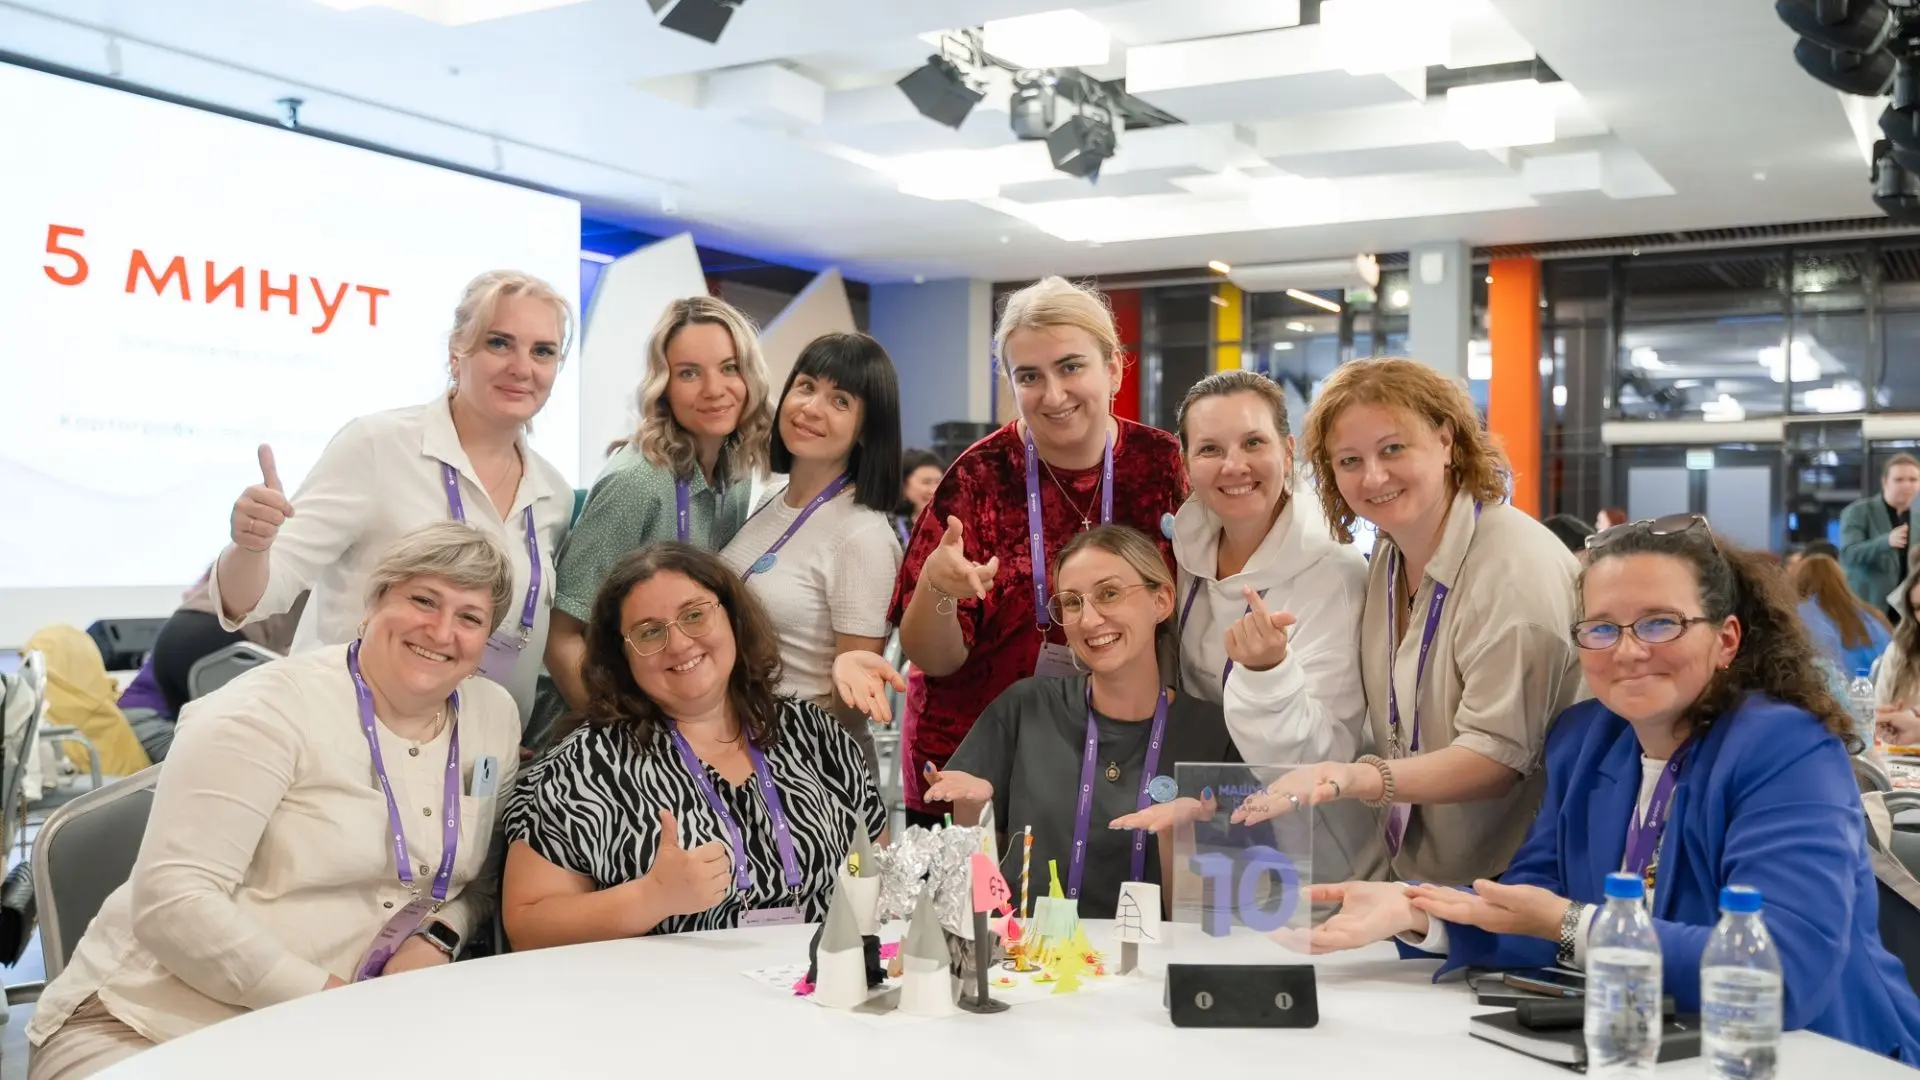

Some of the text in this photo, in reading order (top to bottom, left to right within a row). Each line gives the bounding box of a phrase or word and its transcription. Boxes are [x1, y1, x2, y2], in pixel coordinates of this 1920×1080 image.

[43, 224, 390, 334] 5 минут
[989, 875, 1005, 901] 67
[1188, 845, 1300, 937] 10
